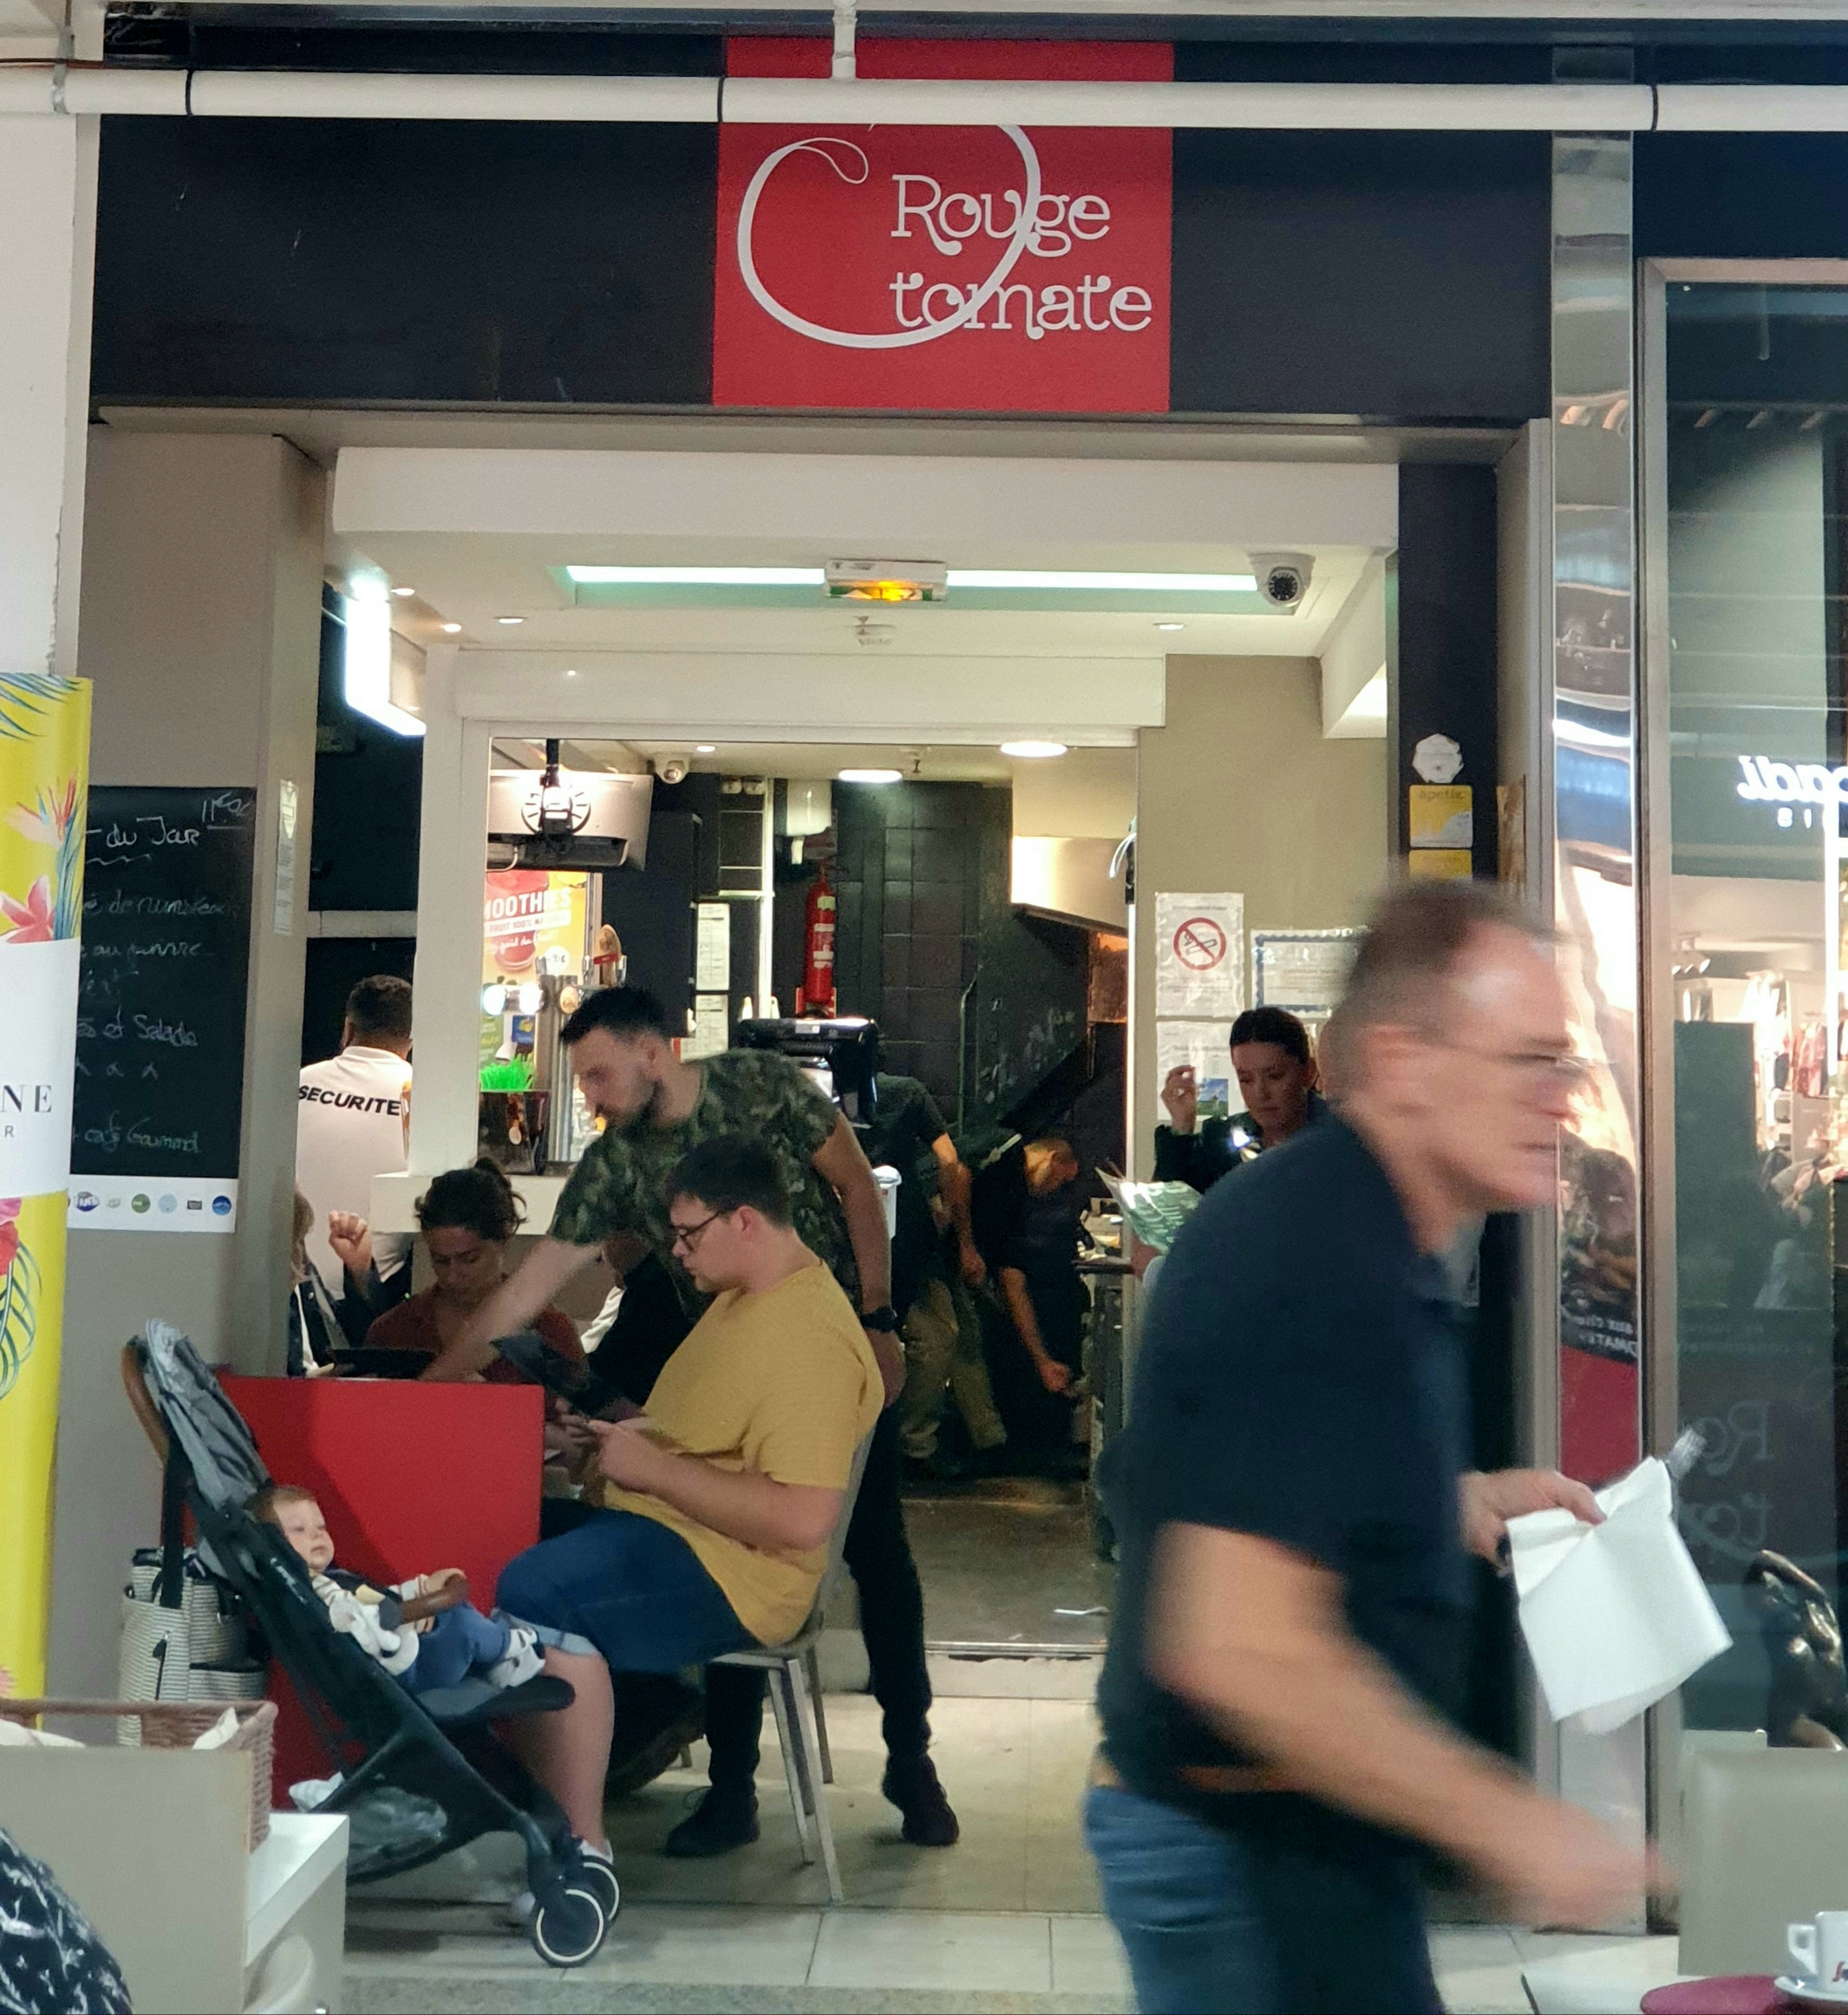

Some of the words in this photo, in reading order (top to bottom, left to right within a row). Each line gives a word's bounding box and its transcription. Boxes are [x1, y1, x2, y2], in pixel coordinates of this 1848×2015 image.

[891, 174, 1110, 256] Rouge
[889, 272, 1152, 340] tomate
[299, 1086, 402, 1117] SECURITE
